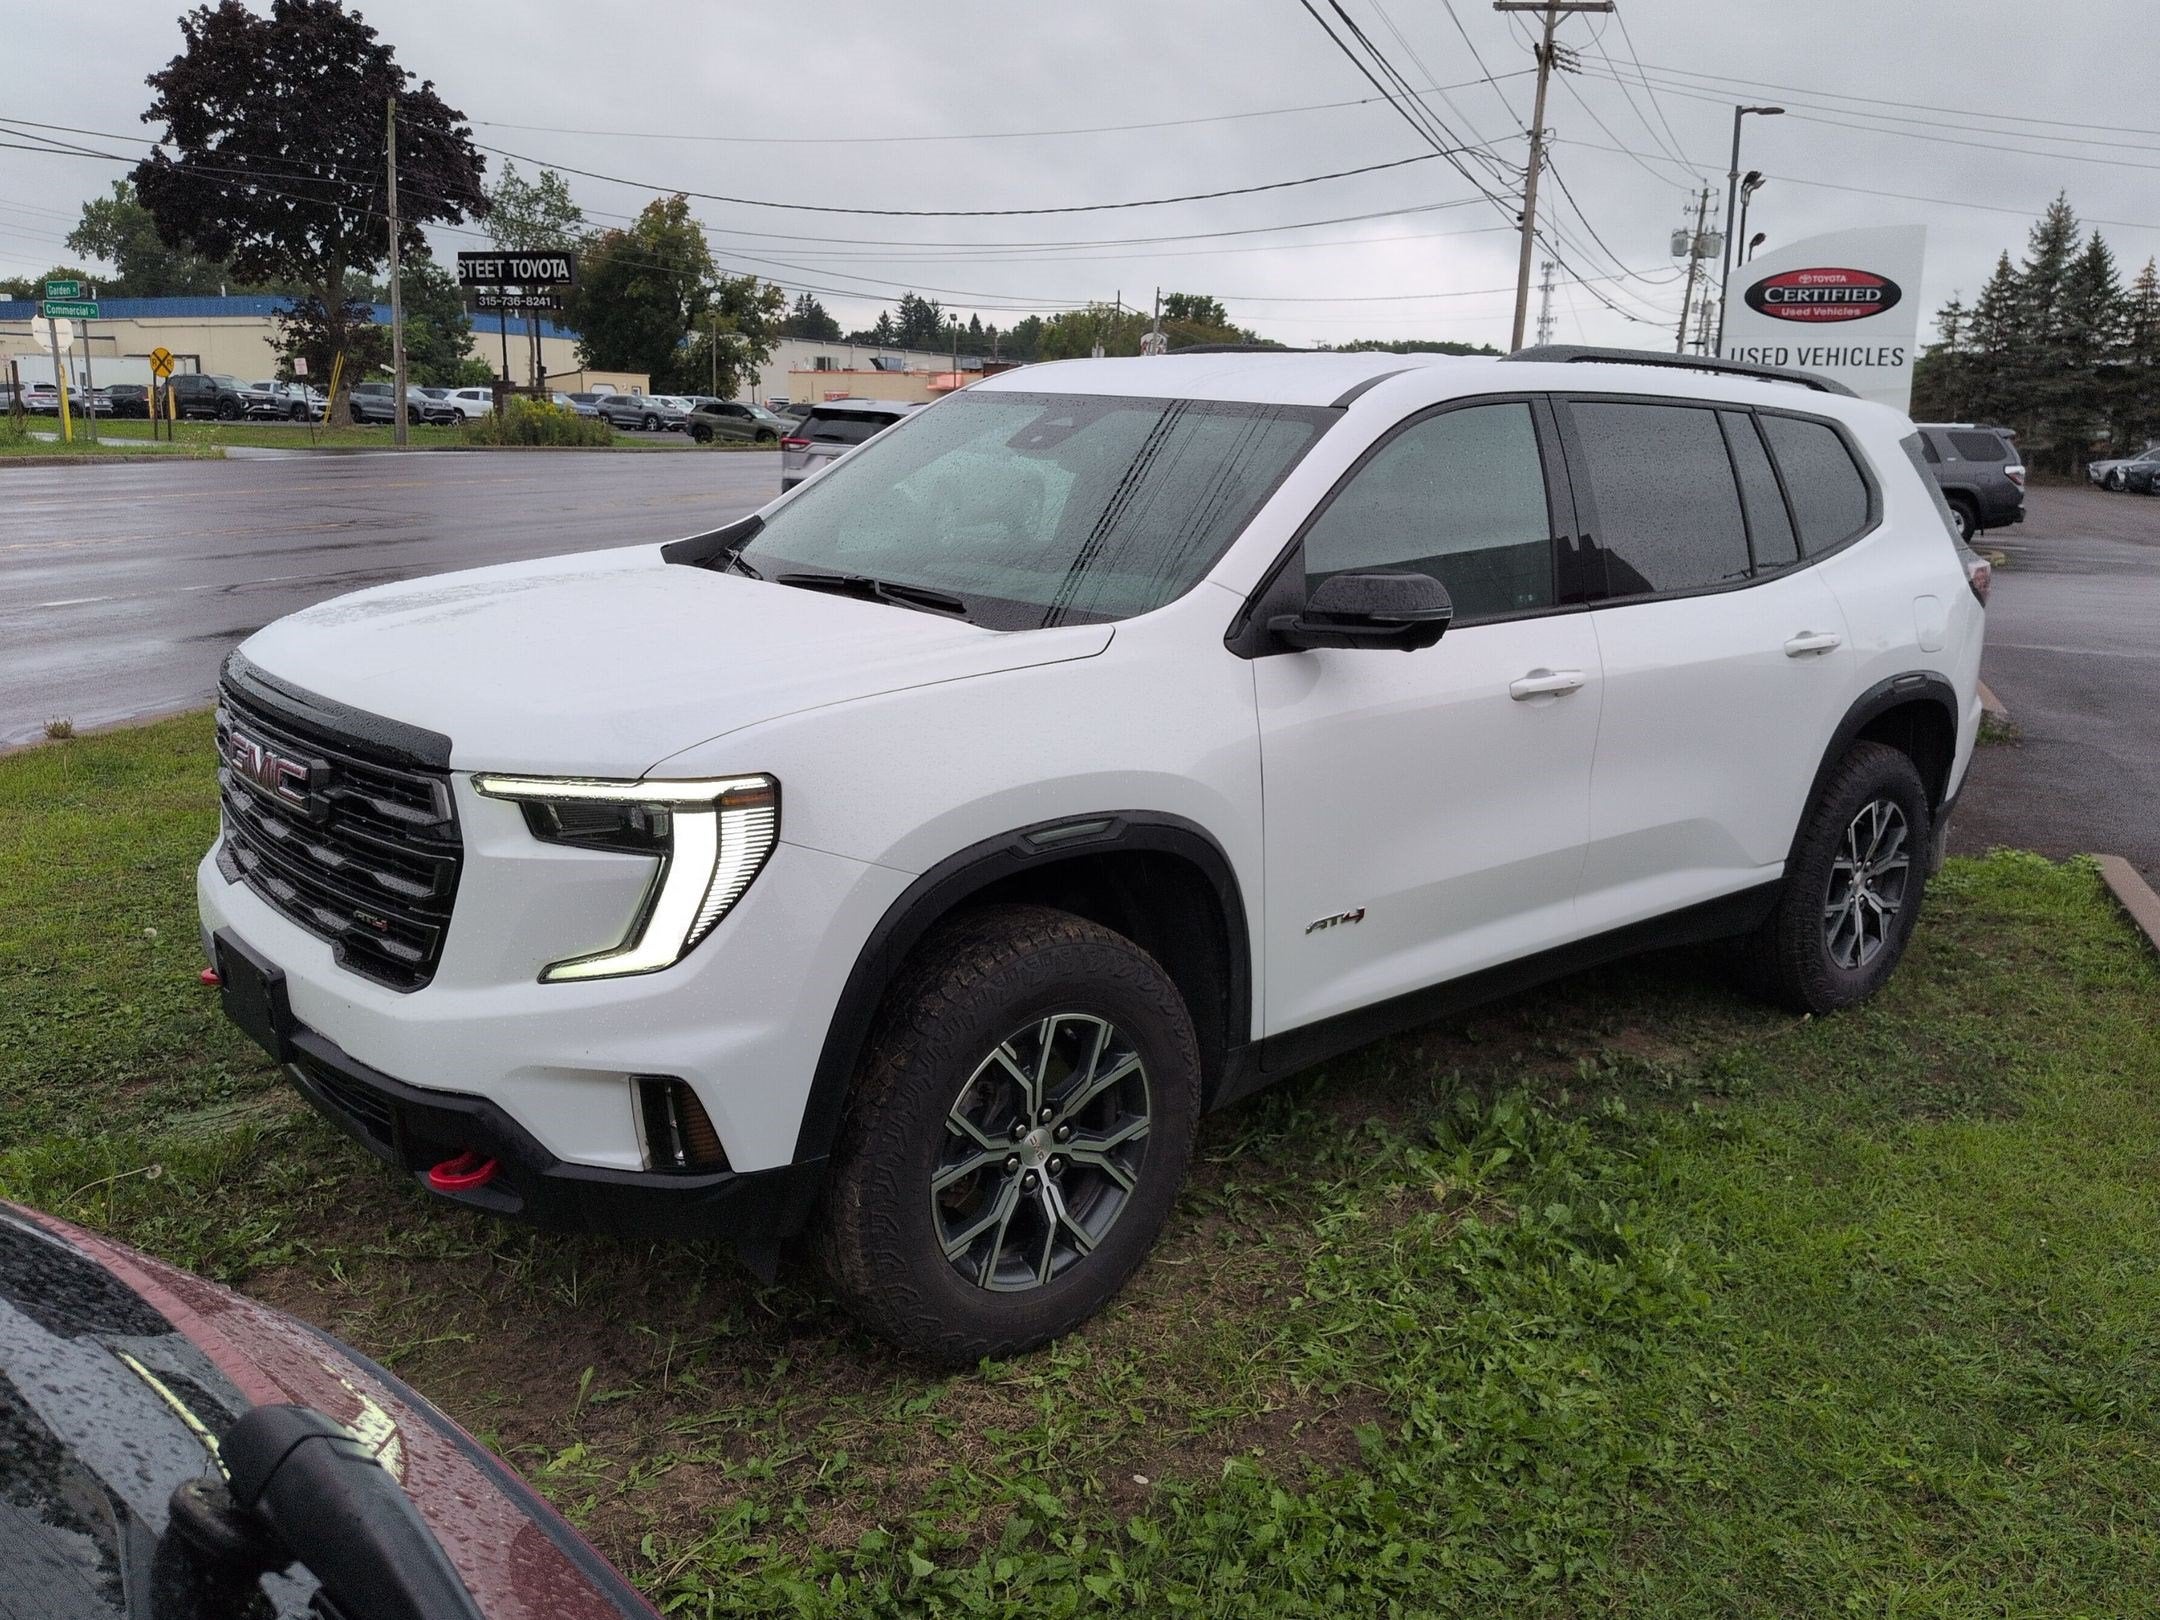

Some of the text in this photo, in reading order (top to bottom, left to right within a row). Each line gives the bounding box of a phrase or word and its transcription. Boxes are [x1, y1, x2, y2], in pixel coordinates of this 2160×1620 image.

[456, 258, 570, 279] STEET TOYOTA
[1812, 274, 1847, 283] TOYOTA
[48, 285, 71, 296] Garden
[1764, 286, 1882, 303] CERTIFIED
[478, 296, 551, 307] 315-736-8241
[46, 304, 89, 316] Commercial
[1781, 306, 1861, 317] Used Vehicles
[1730, 347, 1905, 367] USED VEHICLES
[229, 731, 310, 806] GMC
[1305, 906, 1366, 935] AT4
